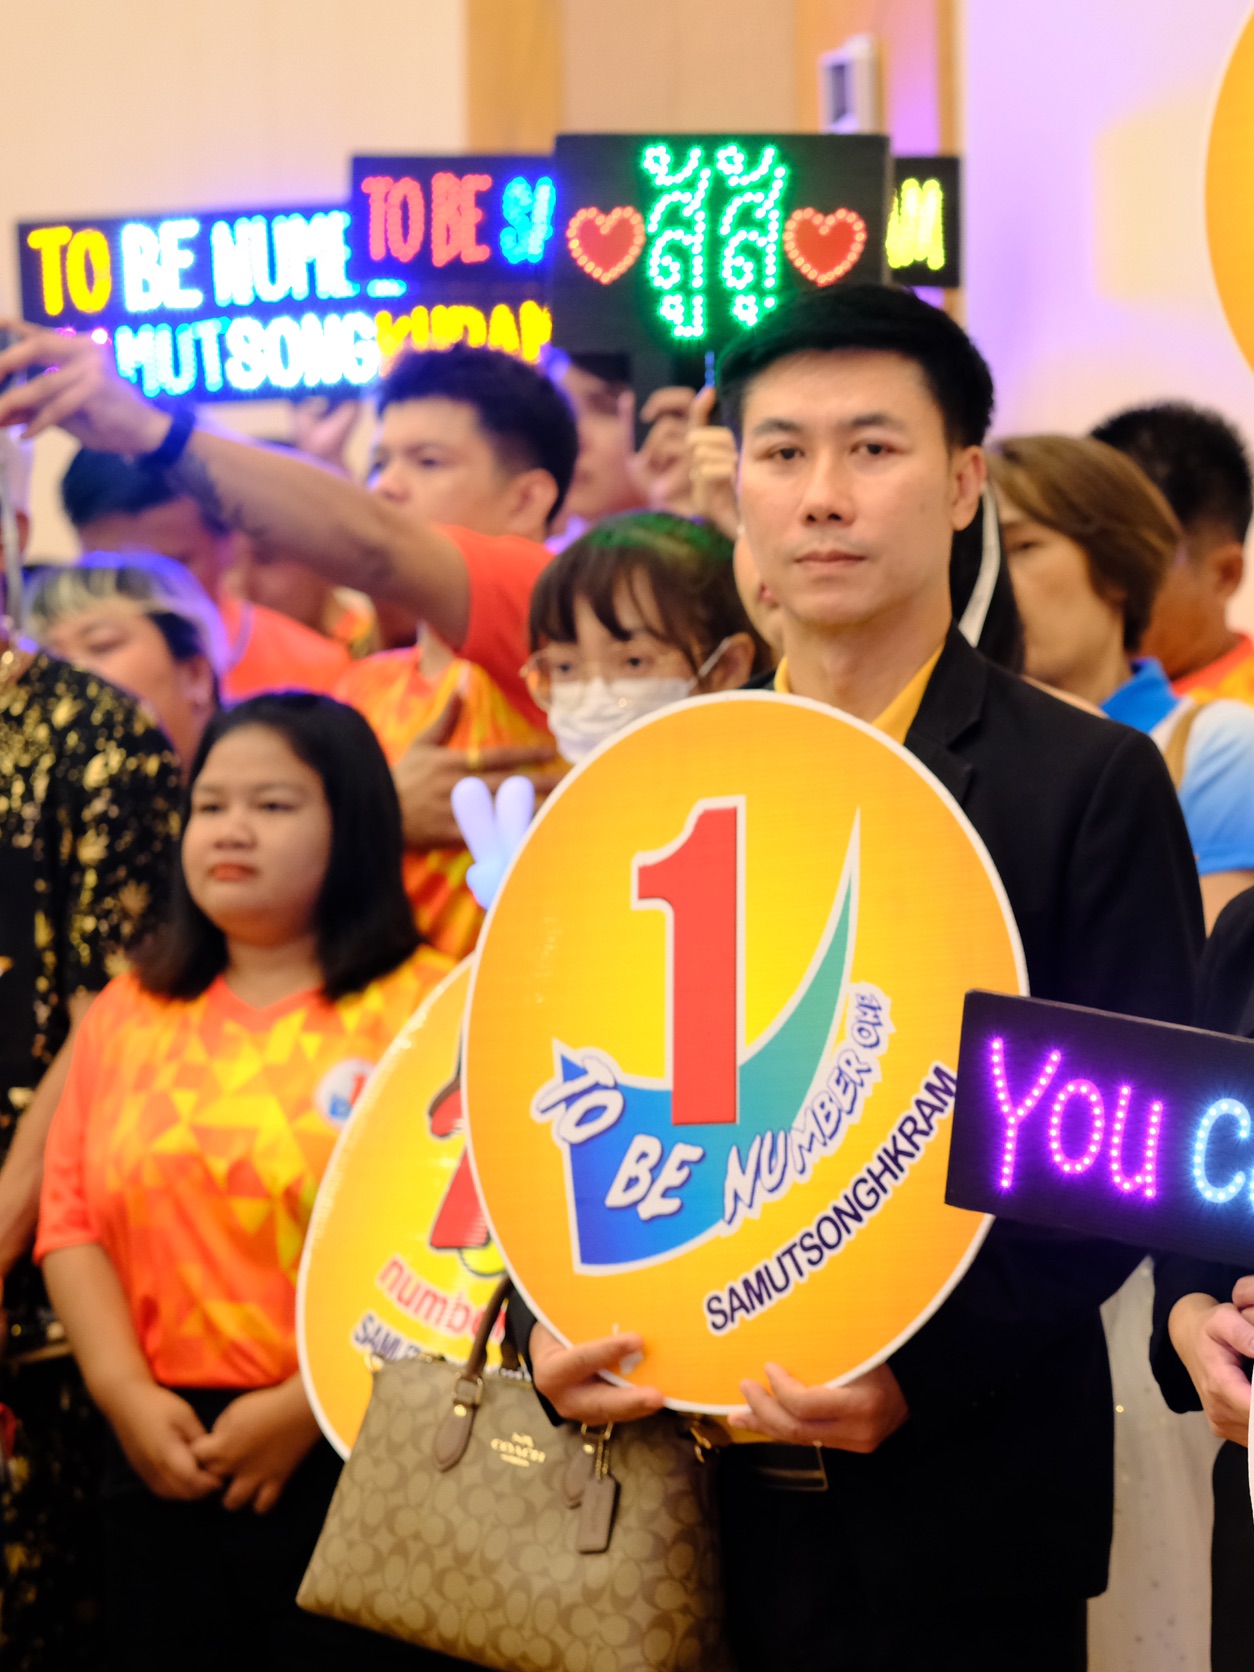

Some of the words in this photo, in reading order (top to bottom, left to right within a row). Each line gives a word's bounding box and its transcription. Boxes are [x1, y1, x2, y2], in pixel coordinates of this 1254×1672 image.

[28, 226, 112, 315] TO
[119, 218, 204, 313] BE
[361, 176, 425, 263] TO
[431, 172, 492, 268] BE
[635, 804, 740, 1125] 1
[536, 1055, 625, 1144] TO
[605, 1133, 706, 1222] BE
[723, 1048, 873, 1226] NUMBER
[706, 1065, 957, 1331] SAMUTSONGHKRAM
